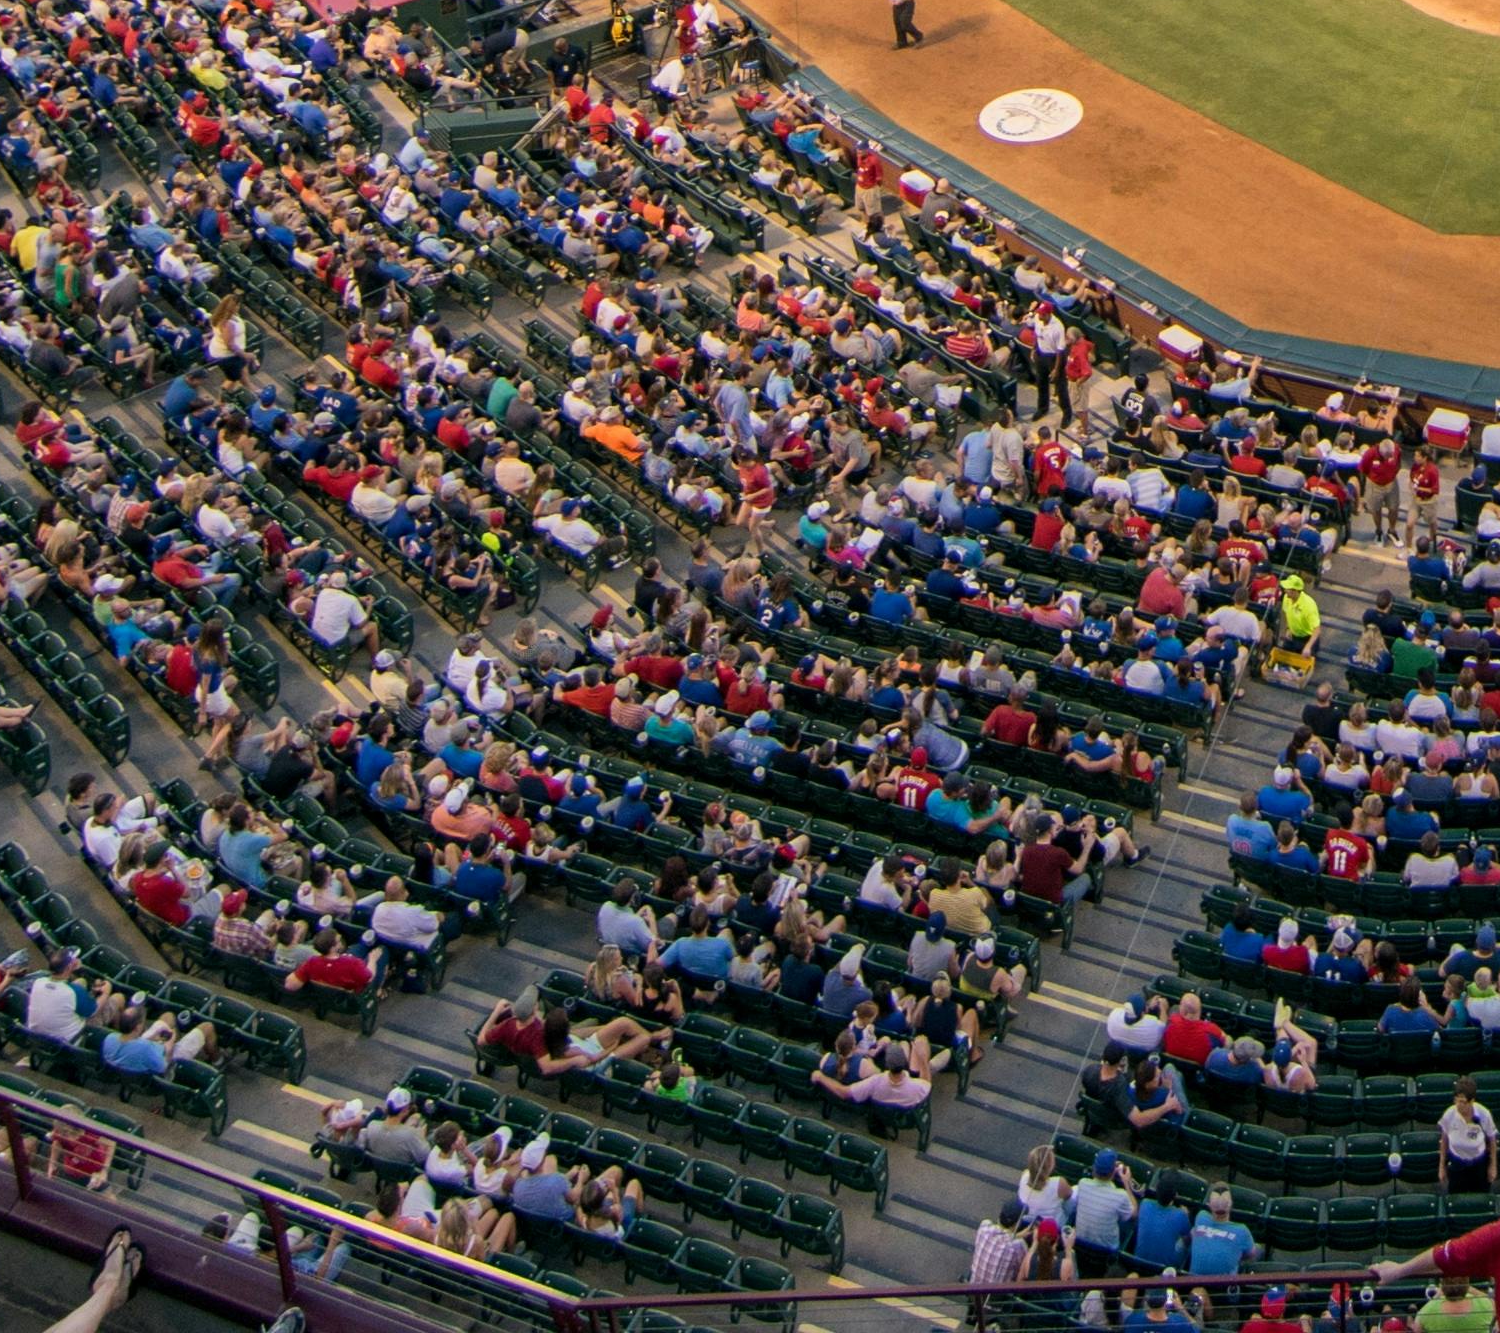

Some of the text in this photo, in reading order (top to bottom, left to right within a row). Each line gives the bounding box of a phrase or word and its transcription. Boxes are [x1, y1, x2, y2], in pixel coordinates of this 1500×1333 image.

[760, 609, 773, 627] 2
[903, 787, 917, 808] 11
[1333, 850, 1348, 872] 11
